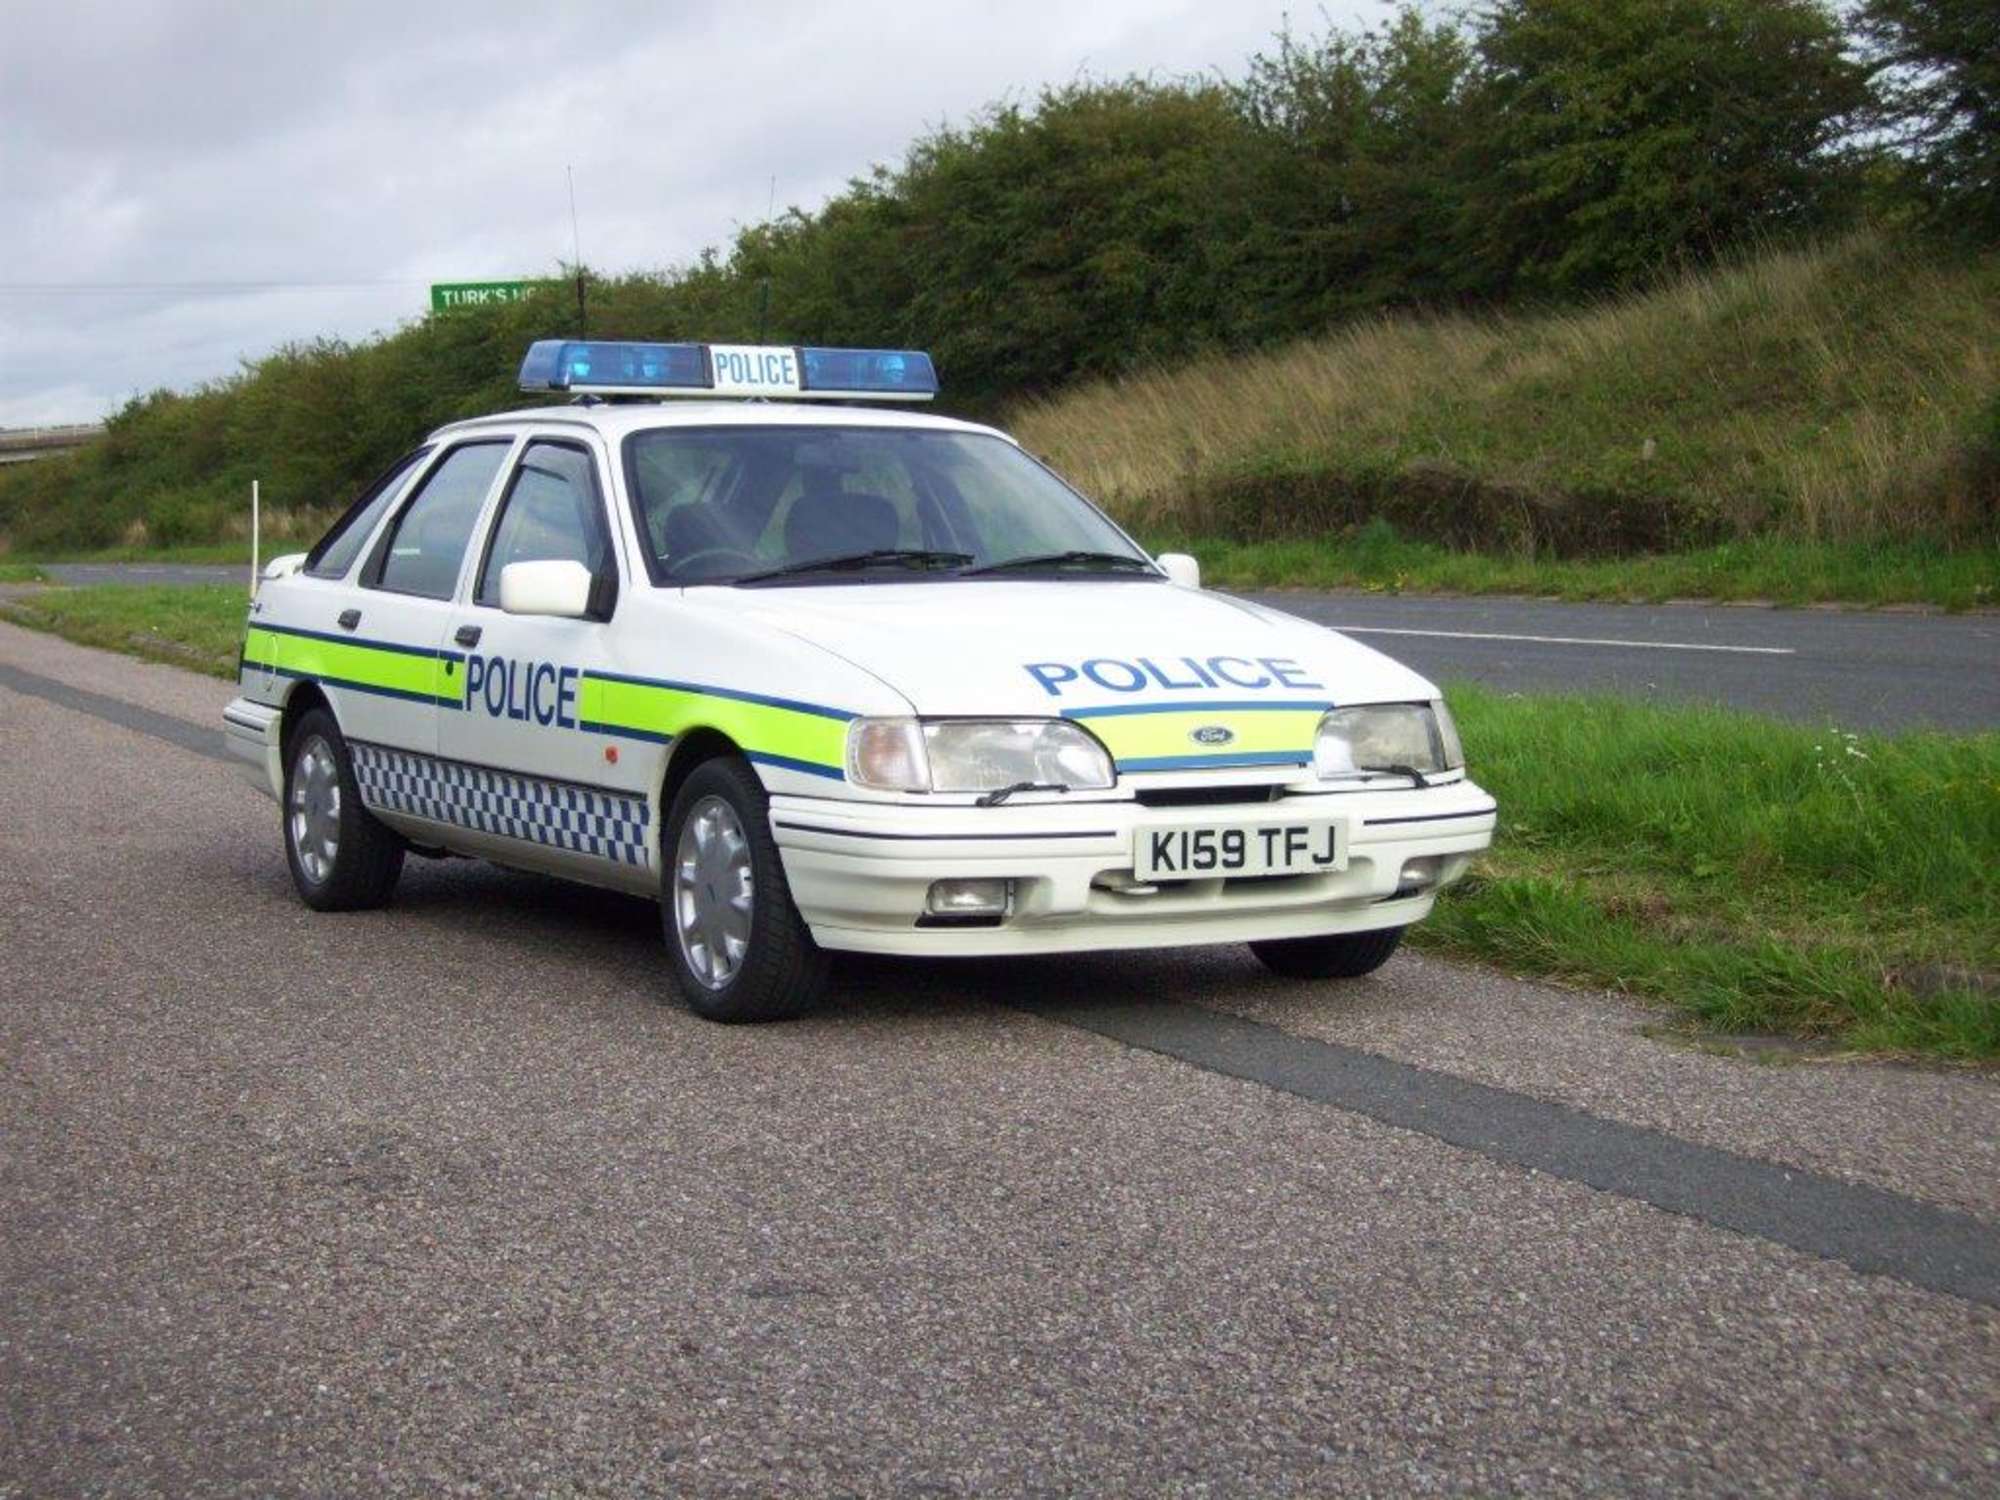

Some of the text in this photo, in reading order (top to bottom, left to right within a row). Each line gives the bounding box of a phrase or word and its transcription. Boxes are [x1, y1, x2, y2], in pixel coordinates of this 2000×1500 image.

[441, 288, 507, 306] TURK'S
[714, 353, 795, 385] POLICE
[466, 655, 578, 729] POLICE
[1023, 656, 1325, 696] POLICE
[1151, 825, 1335, 872] K159 TFJ
